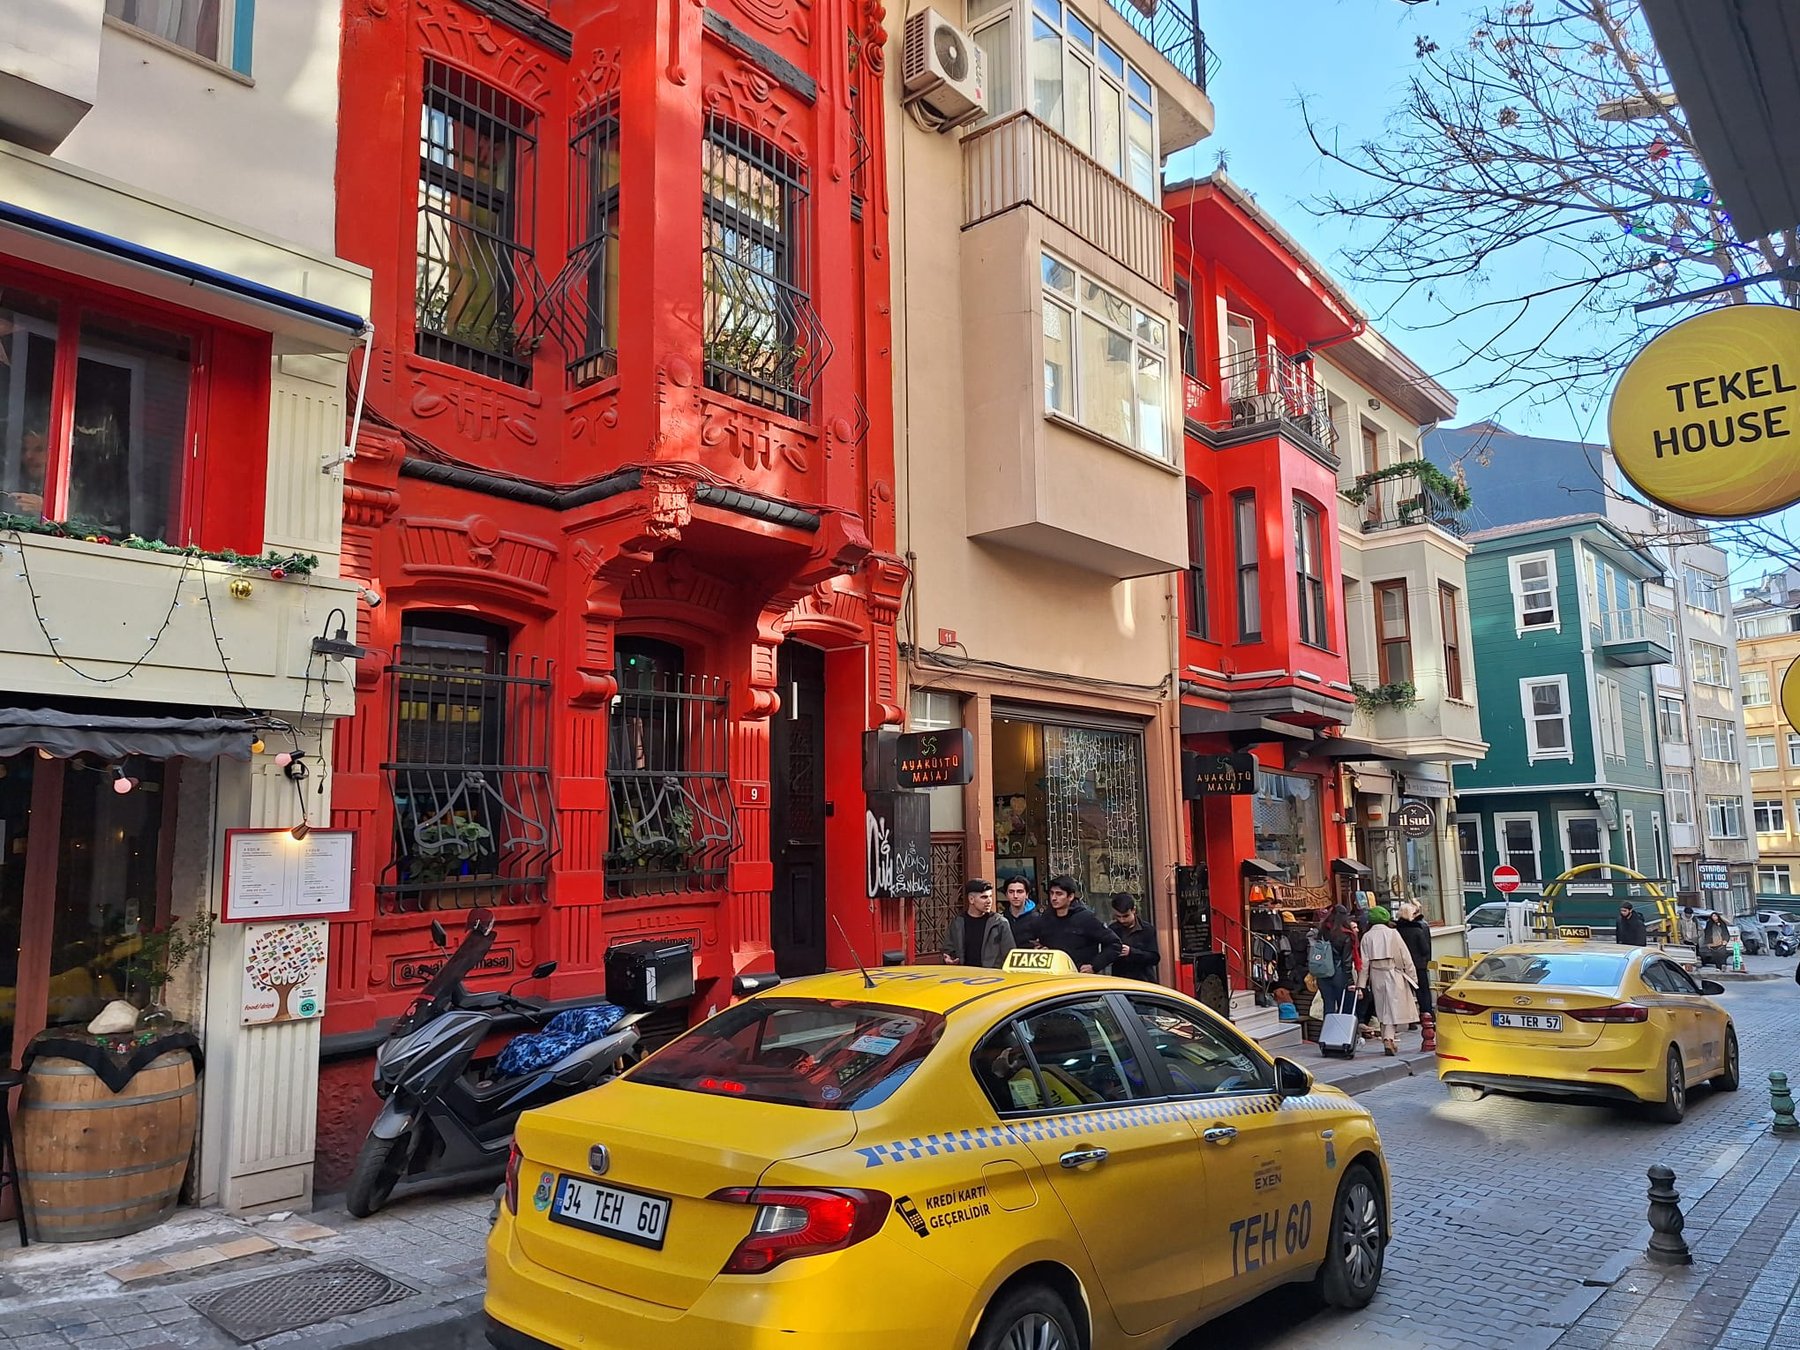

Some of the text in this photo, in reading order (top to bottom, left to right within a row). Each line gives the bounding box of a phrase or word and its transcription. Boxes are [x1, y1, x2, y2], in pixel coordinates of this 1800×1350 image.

[1665, 363, 1798, 413] TEKEL
[1653, 405, 1791, 459] HOUSE
[912, 769, 949, 783] MASAJ
[751, 787, 758, 800] 9
[1207, 782, 1241, 792] MASAJ
[1399, 814, 1430, 826] il sud
[1500, 1014, 1558, 1029] 34 TER 57
[1255, 1174, 1282, 1190] EXEN
[926, 1185, 987, 1210] KREDİ KARTI
[563, 1183, 581, 1215] 34
[593, 1189, 625, 1226] TEH
[637, 1201, 661, 1235] 60
[929, 1202, 992, 1229] GEÇERLİDİR
[1229, 1199, 1312, 1277] TEH 60
